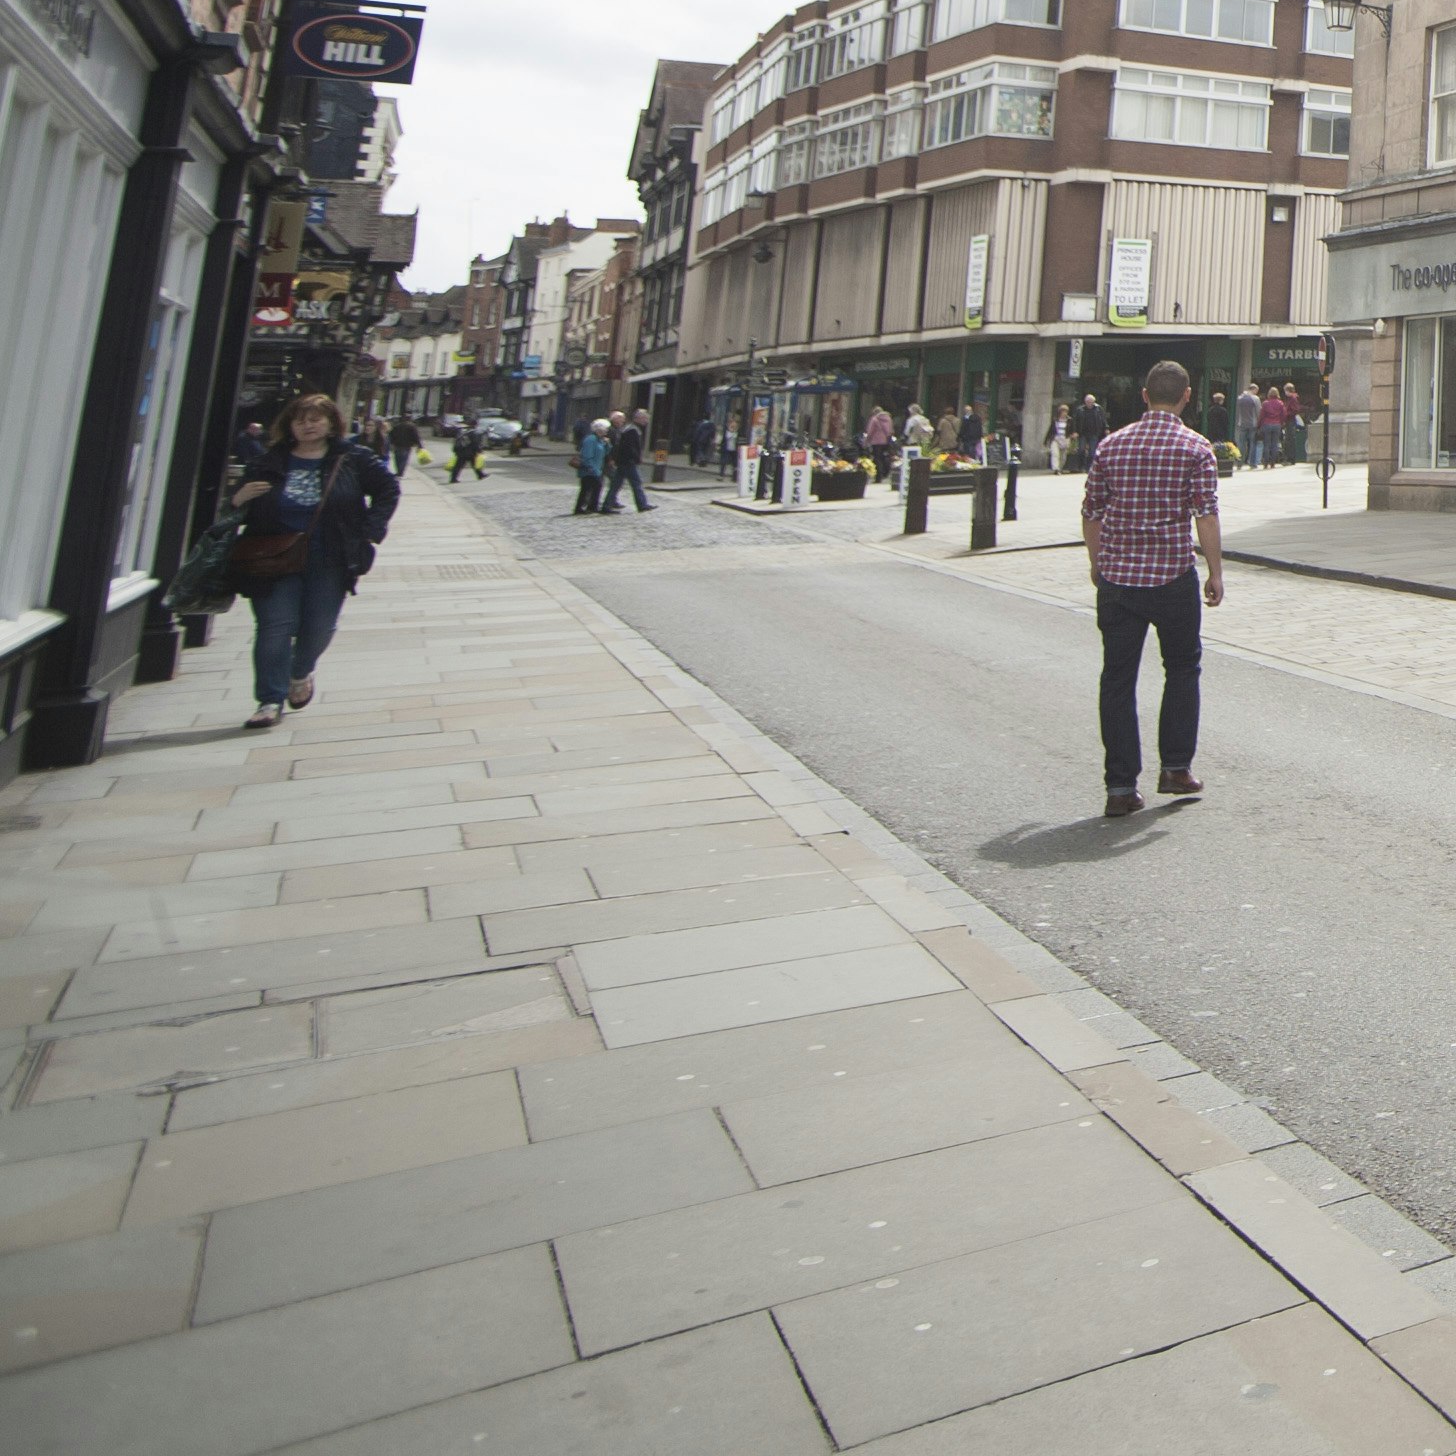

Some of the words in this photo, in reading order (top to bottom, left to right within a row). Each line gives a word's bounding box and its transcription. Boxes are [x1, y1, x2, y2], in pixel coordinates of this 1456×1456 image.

[322, 40, 386, 66] HILL
[1391, 263, 1412, 291] The
[1114, 295, 1126, 304] TO
[1128, 295, 1145, 304] LET
